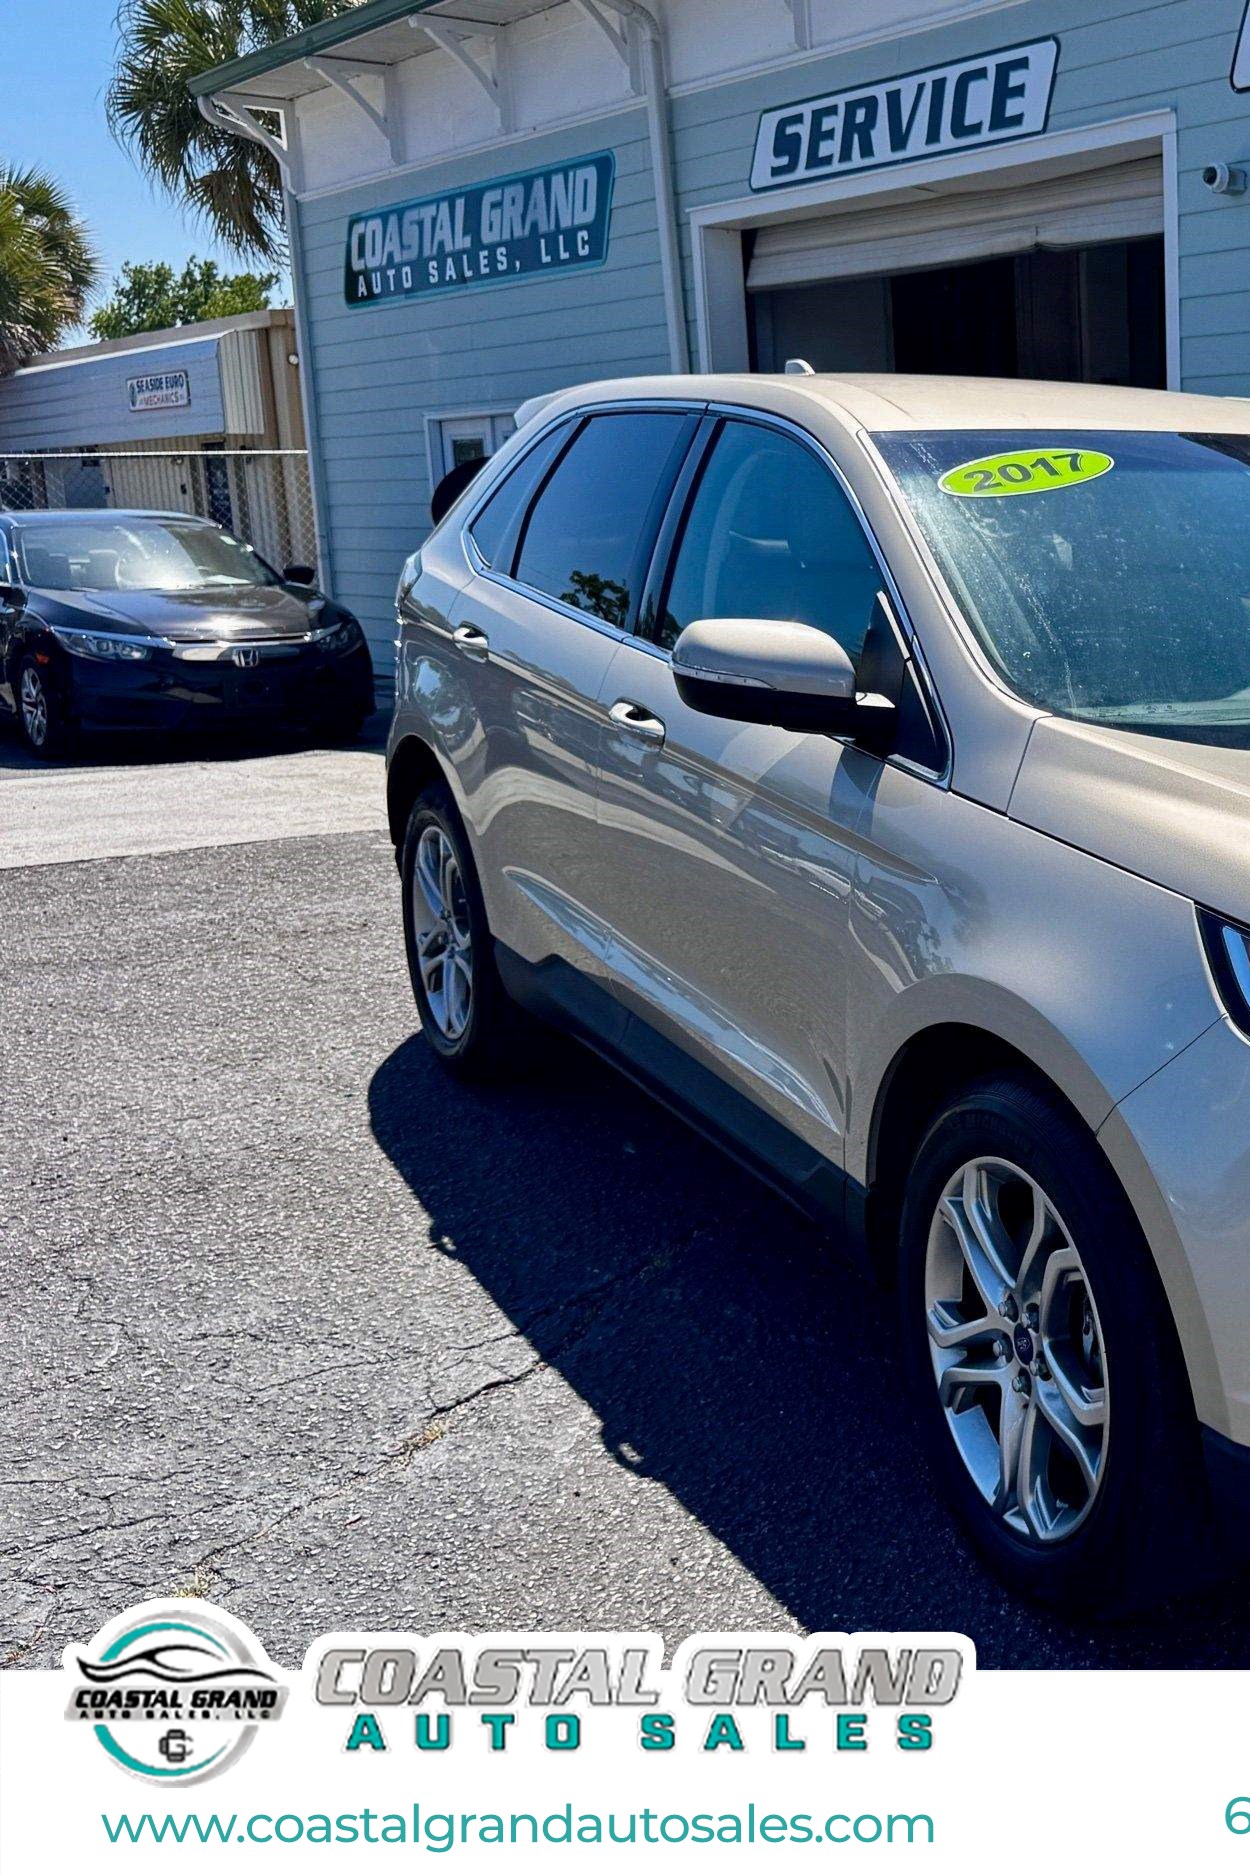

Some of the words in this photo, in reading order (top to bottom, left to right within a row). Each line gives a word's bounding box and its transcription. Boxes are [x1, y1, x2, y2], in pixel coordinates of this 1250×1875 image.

[770, 56, 1030, 178] SERVICE
[350, 195, 472, 272] COASTAL
[480, 165, 598, 245] GRAND
[357, 265, 412, 298] AUTO
[428, 246, 521, 285] SALES,
[539, 230, 590, 264] LLC
[136, 376, 164, 394] SEASIDE
[164, 374, 184, 389] EURO
[963, 452, 1083, 493] 2017
